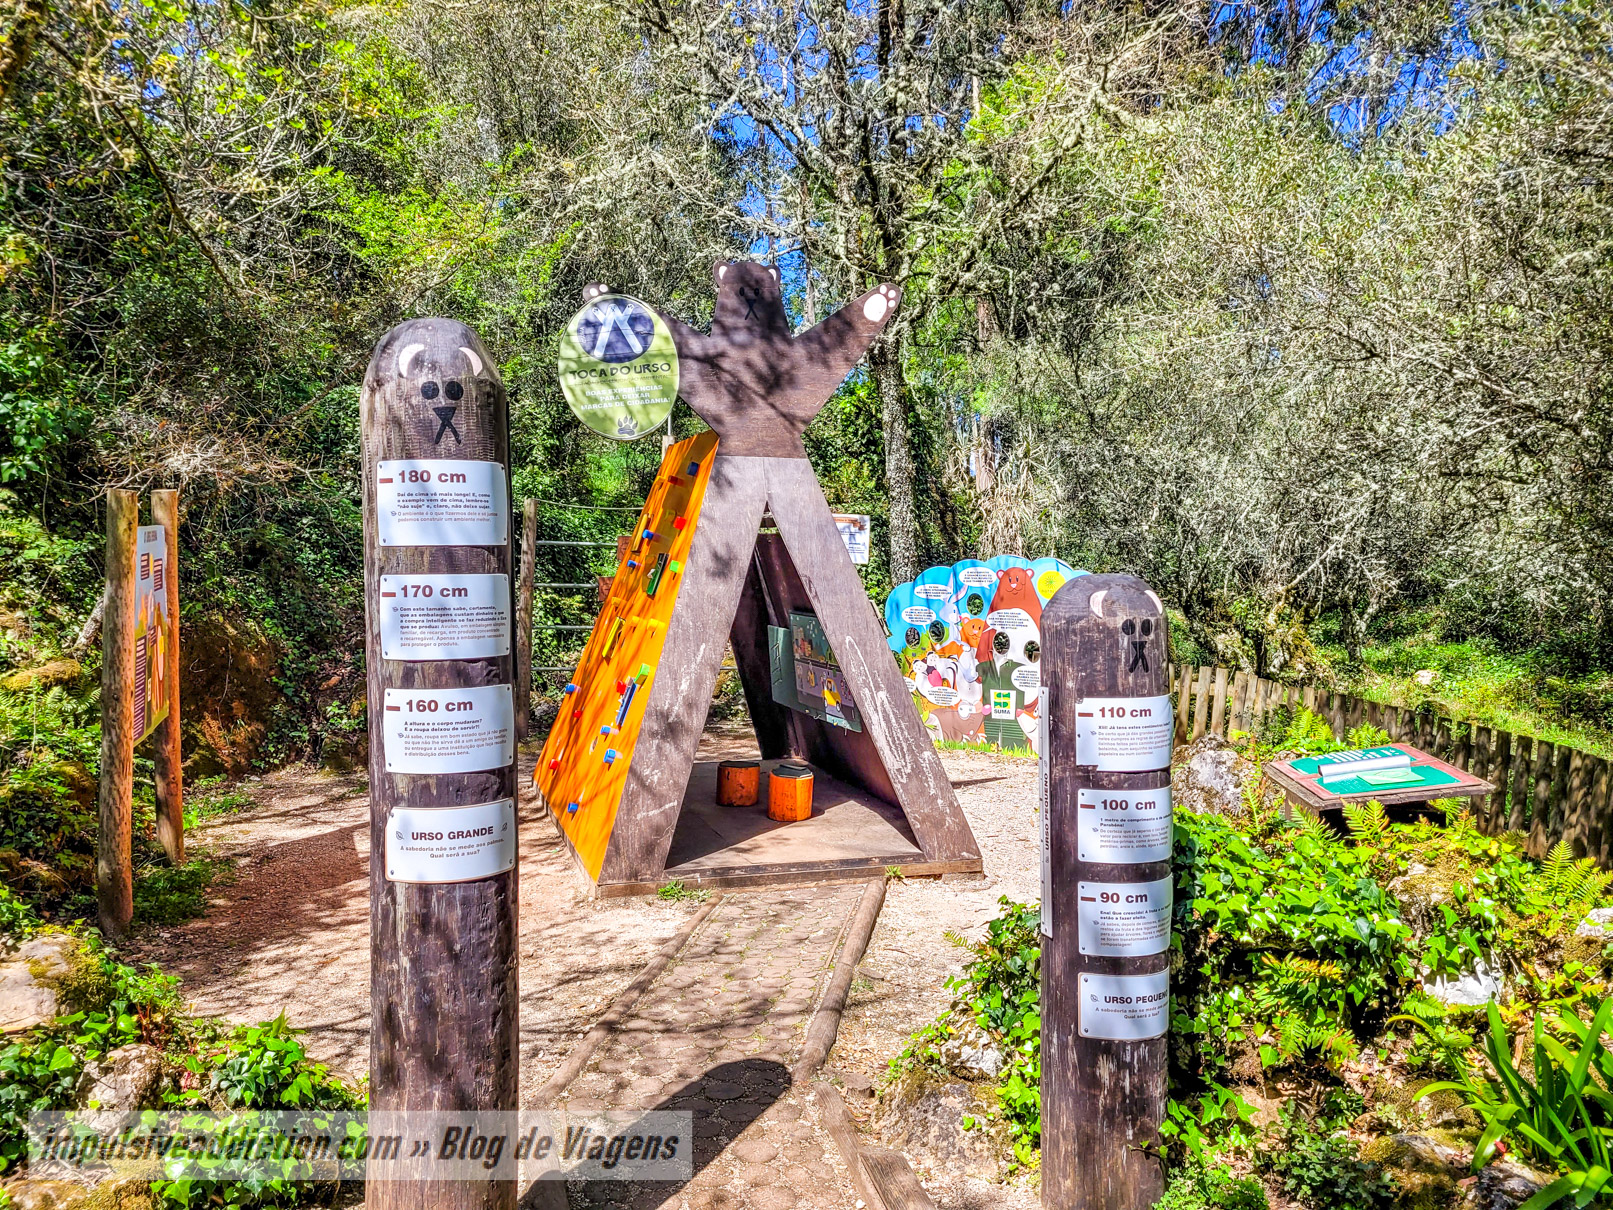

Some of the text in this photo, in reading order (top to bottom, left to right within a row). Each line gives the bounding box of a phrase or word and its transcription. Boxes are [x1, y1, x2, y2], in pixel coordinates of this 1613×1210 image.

[569, 362, 671, 380] TOCA DO URSO
[581, 402, 613, 410] MARCAS
[399, 470, 466, 483] 180 cm
[401, 585, 468, 597] 170 cm
[406, 700, 473, 712] 160 cm
[1099, 707, 1152, 718] 110 cm
[1100, 799, 1156, 810] 100 cm
[412, 826, 494, 840] URSO GRANDE
[1100, 892, 1148, 903] 90 cm
[1104, 989, 1167, 1004] URSO PEQUEN
